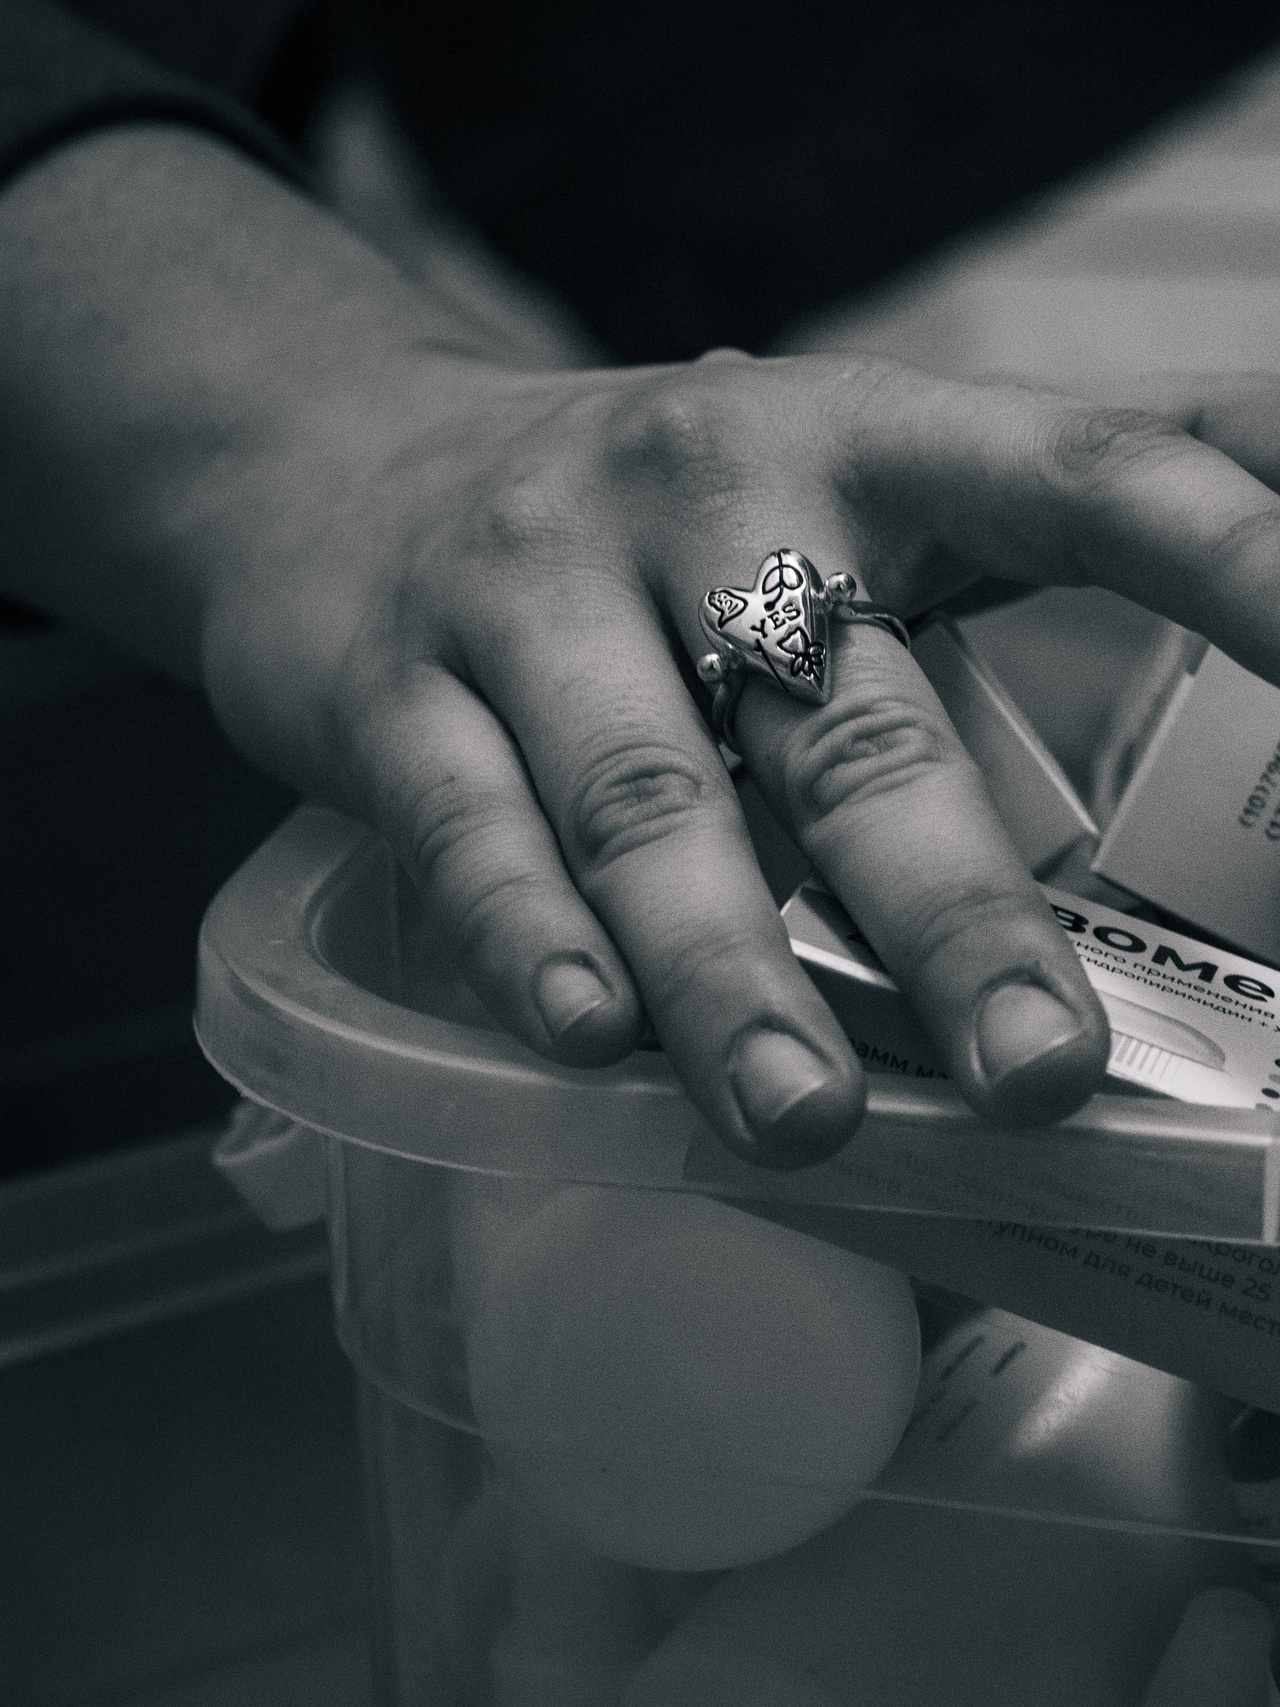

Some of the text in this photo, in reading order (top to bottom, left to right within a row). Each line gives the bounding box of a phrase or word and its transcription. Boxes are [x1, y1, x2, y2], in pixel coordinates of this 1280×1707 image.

[750, 601, 800, 639] YES
[1074, 940, 1128, 965] ного
[1133, 959, 1276, 1020] применения
[1082, 1250, 1133, 1280] для
[1134, 1271, 1213, 1311] детей
[1163, 1250, 1236, 1290] выше
[1240, 1275, 1273, 1303] 25
